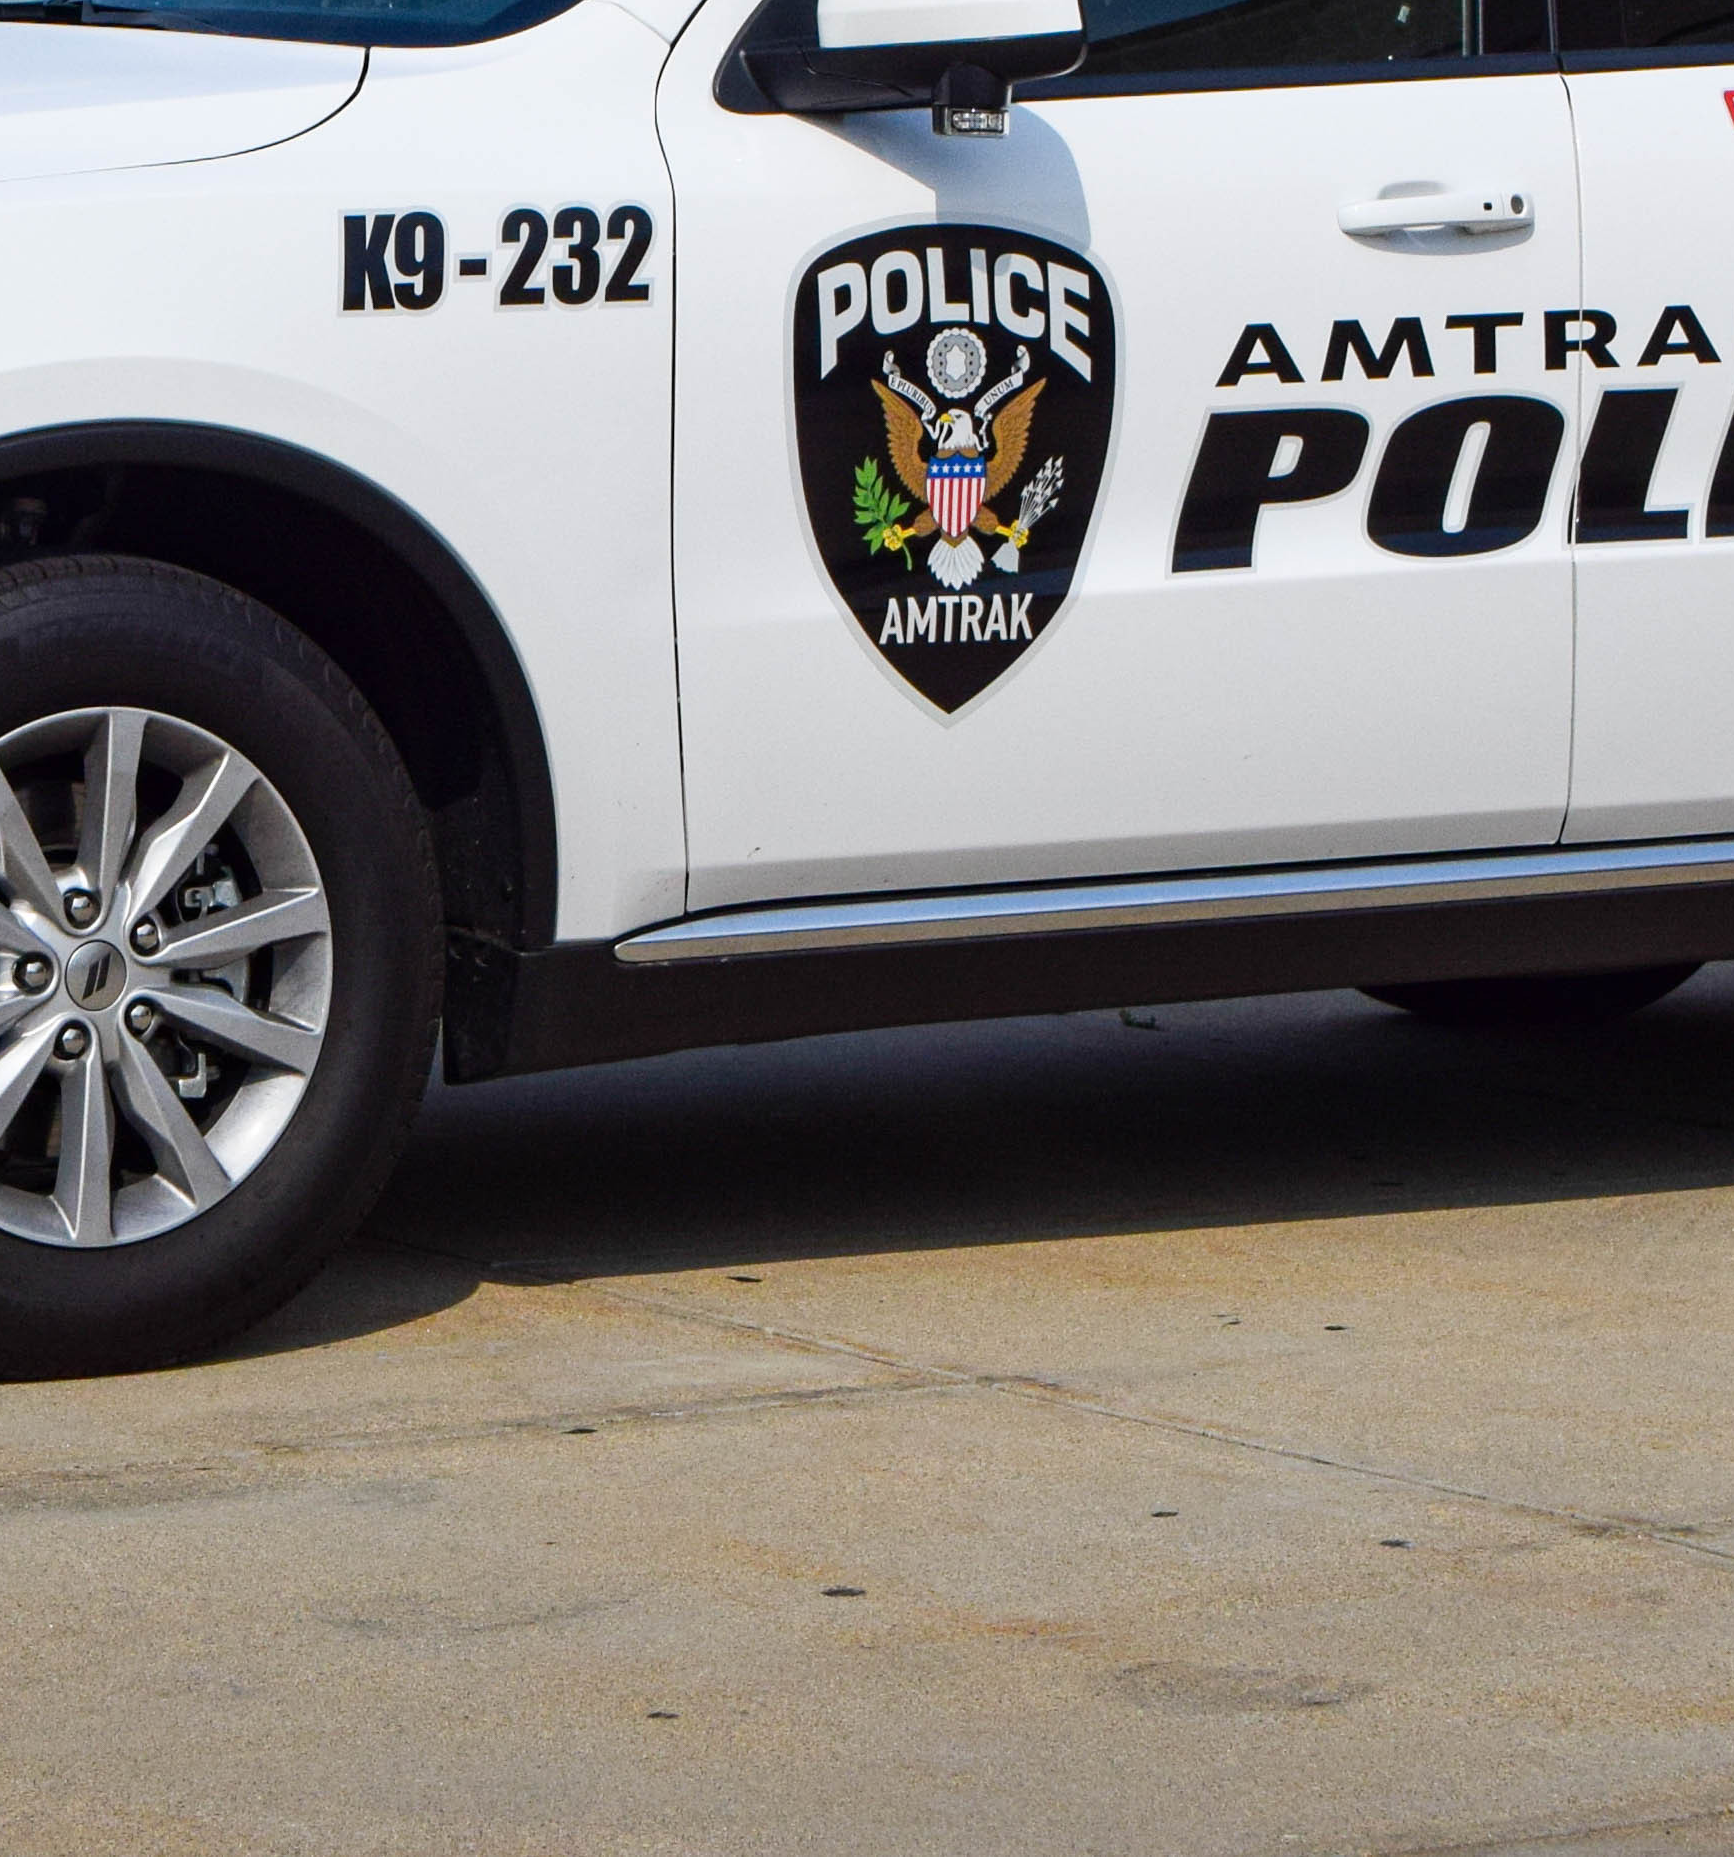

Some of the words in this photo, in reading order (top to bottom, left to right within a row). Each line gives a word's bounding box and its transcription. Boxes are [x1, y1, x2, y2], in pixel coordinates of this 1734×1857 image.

[342, 205, 653, 310] K9-232
[816, 246, 1092, 382] POLICE
[897, 381, 935, 416] PLURIBUS
[983, 378, 1015, 407] UNUM
[878, 592, 1035, 645] AMTRAK
